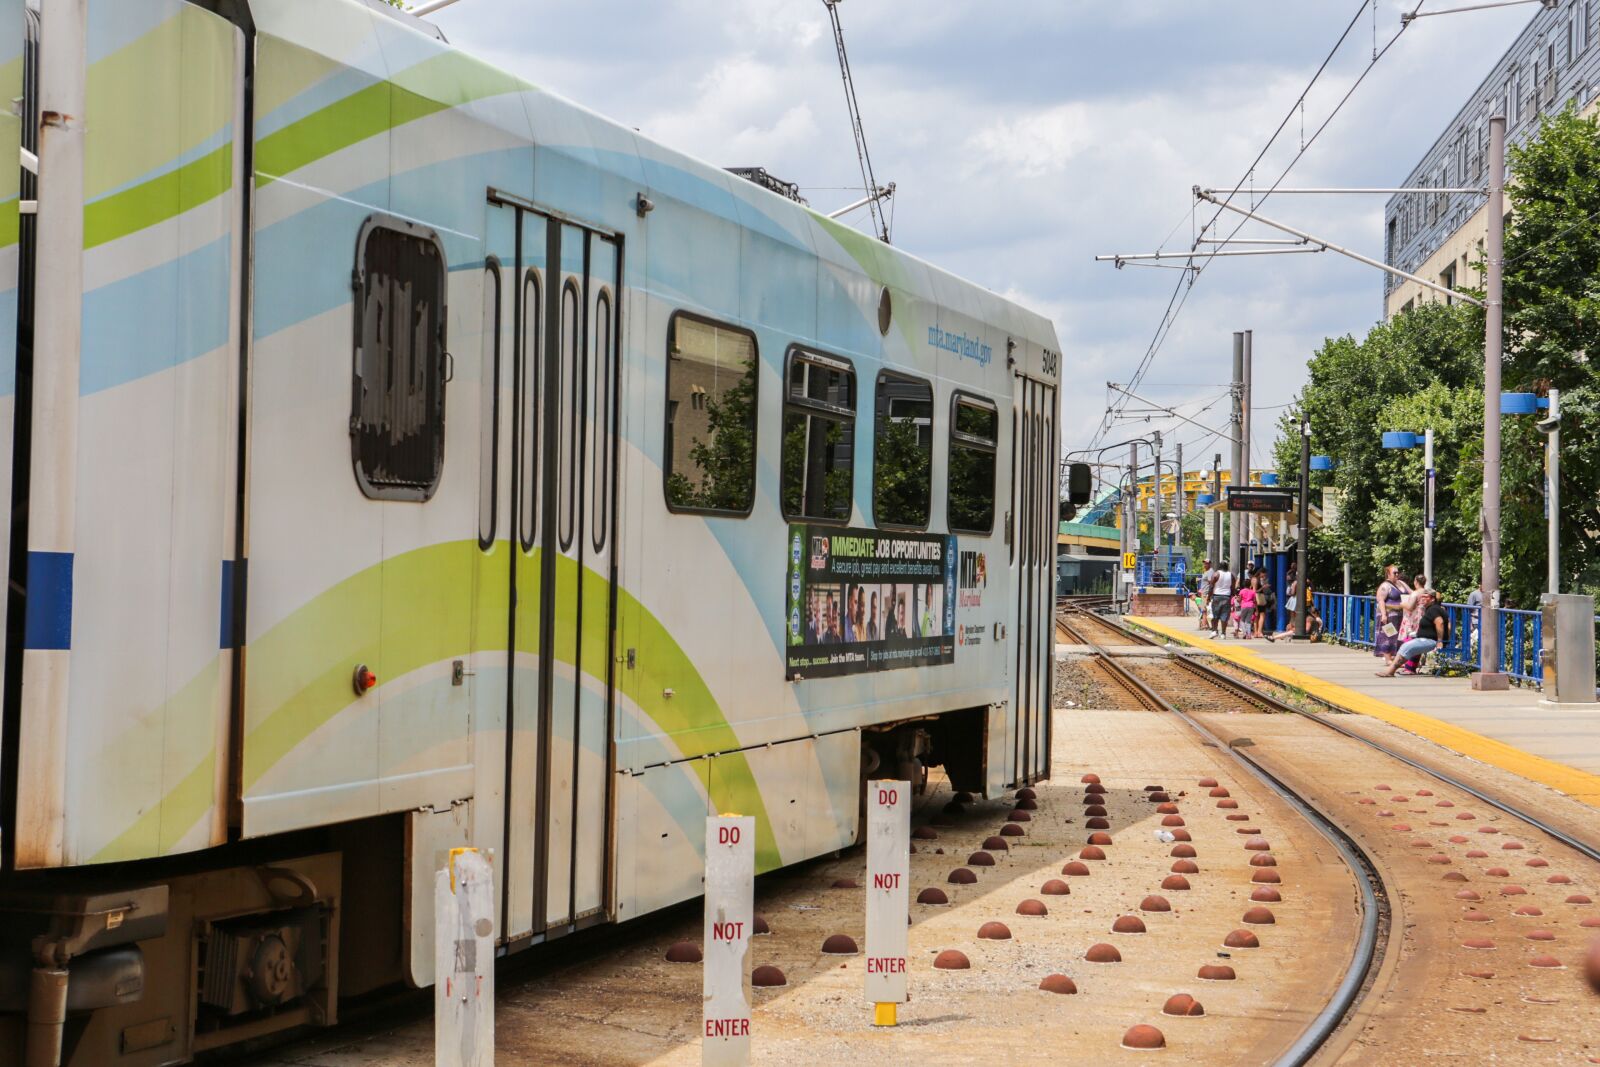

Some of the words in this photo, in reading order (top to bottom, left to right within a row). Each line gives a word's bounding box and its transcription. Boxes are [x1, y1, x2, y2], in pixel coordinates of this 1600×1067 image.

[928, 326, 992, 367] mta.maryland.gov
[1042, 348, 1057, 378] 5048
[831, 536, 875, 558] IMMEDIATE
[875, 539, 890, 559] JOB
[891, 540, 941, 560] OPPORTUNITIES
[831, 558, 836, 573] A
[836, 560, 851, 574] secure
[881, 559, 890, 575] and
[890, 560, 907, 576] excellent
[960, 551, 977, 589] MTA
[789, 656, 799, 667] Next
[830, 653, 838, 664] Join
[846, 652, 854, 663] MTA
[879, 790, 897, 805] DO
[719, 827, 740, 844] DO
[874, 874, 901, 889] NOT
[713, 922, 743, 940] NOT
[867, 958, 905, 973] ENTER
[705, 1019, 749, 1037] ENTER
